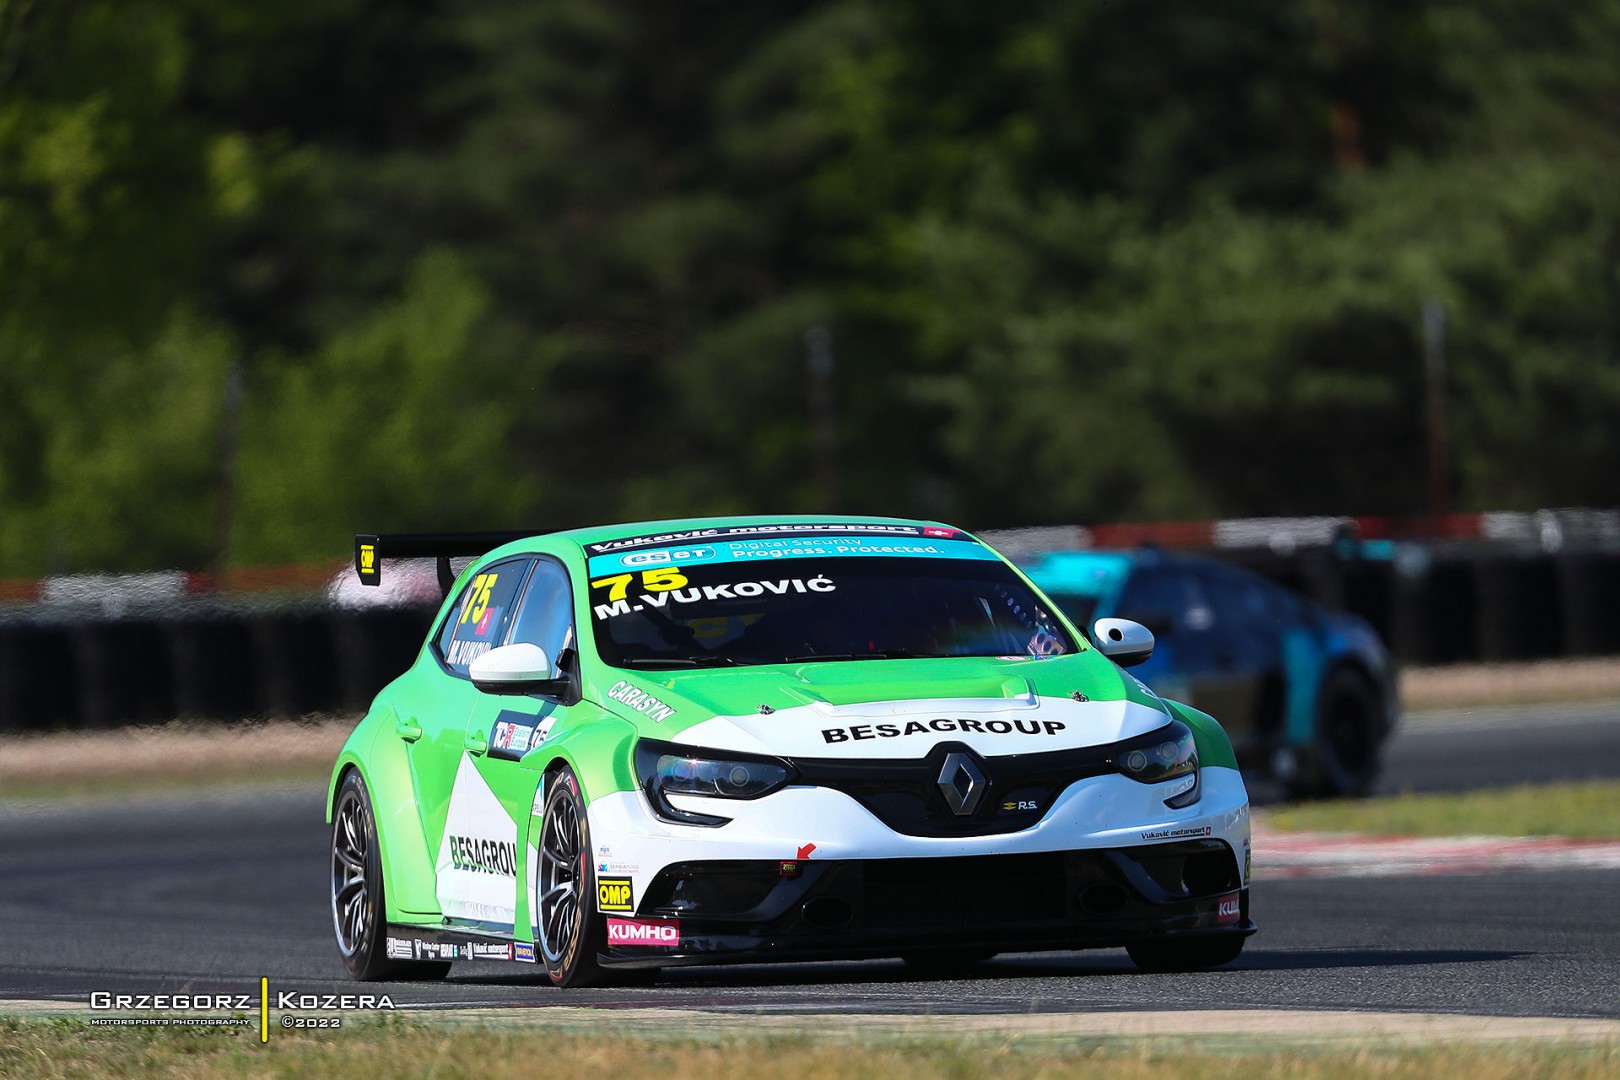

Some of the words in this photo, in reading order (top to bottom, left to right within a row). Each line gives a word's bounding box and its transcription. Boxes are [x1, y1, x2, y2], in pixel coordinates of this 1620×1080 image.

[591, 529, 717, 552] Vuković
[729, 524, 918, 534] motorsport
[729, 539, 788, 550] Digital
[792, 538, 861, 547] Security
[360, 549, 375, 568] OMP
[732, 545, 833, 558] Progress.
[836, 545, 945, 554] Protected.
[591, 566, 689, 602] 75
[460, 573, 499, 624] 75
[593, 574, 836, 620] M.VUKOVIĆ
[607, 680, 678, 723] CARASYN
[493, 721, 517, 750] TCR
[821, 719, 1066, 744] BESAGROUP
[1018, 801, 1038, 810] R.S.
[1141, 830, 1169, 840] Vuković
[1170, 827, 1206, 837] motorsport
[599, 885, 631, 905] OMP
[608, 924, 677, 941] KUMHO
